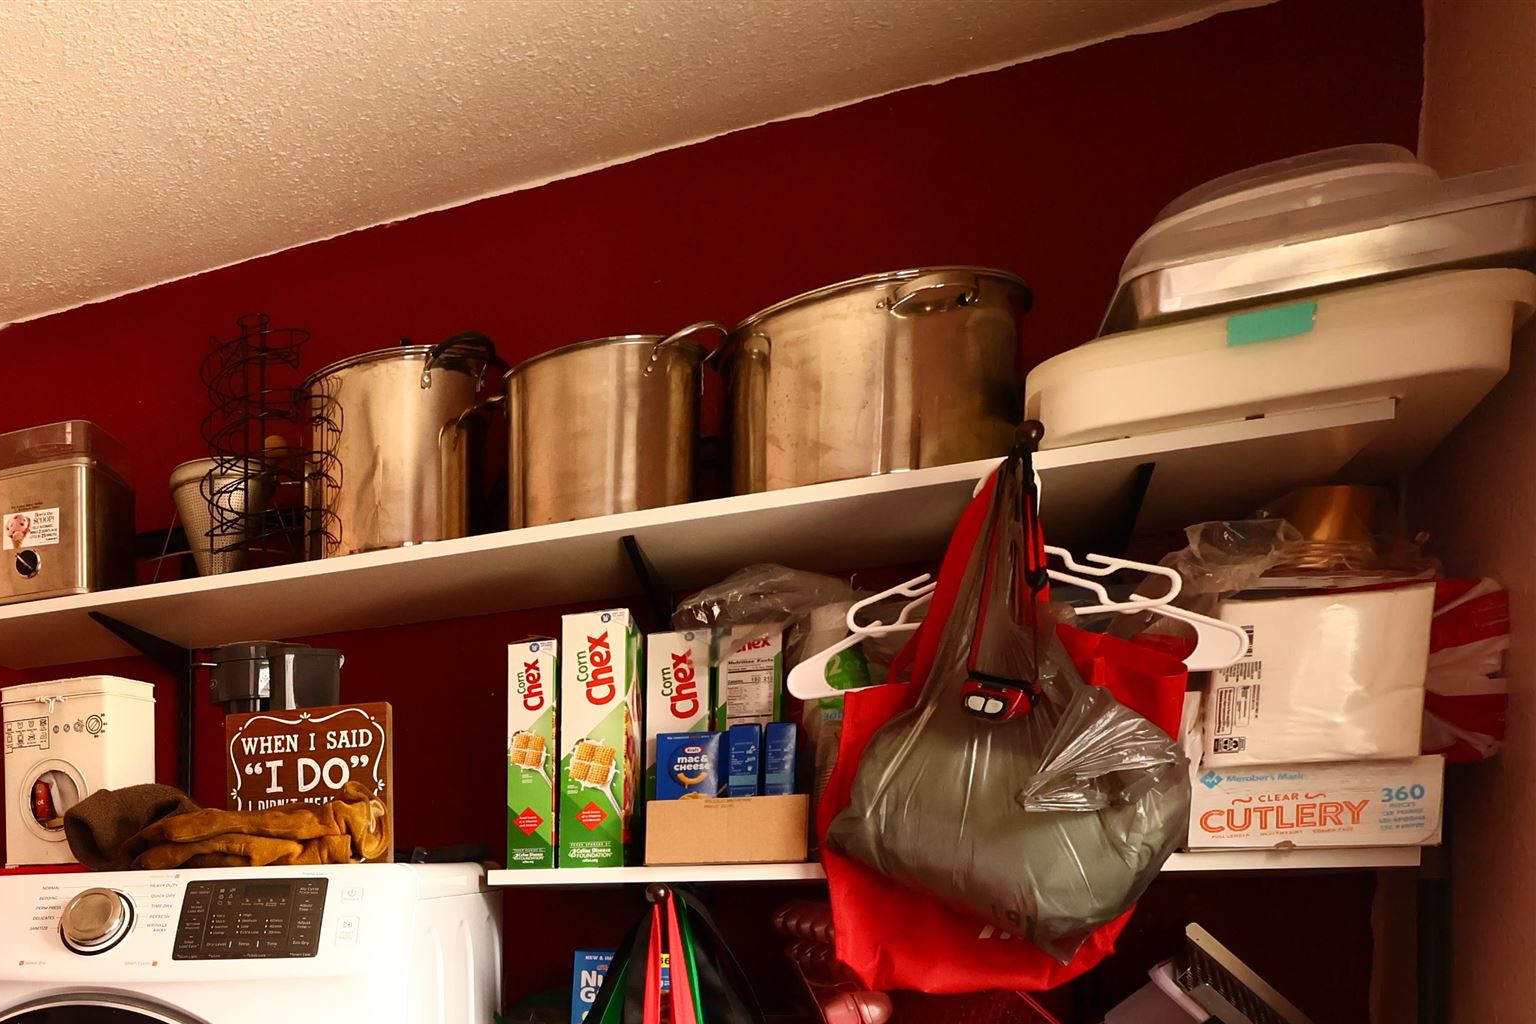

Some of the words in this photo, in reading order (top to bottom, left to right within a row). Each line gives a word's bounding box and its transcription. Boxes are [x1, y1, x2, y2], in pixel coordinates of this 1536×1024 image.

[577, 650, 589, 682] Corn
[586, 630, 616, 706] Chex
[517, 671, 526, 694] Corn
[523, 658, 545, 712] Chex
[661, 667, 673, 697] Corn
[670, 648, 699, 719] Chex
[241, 734, 299, 756] WHEN
[309, 733, 316, 751] I
[326, 728, 373, 750] SAID
[1226, 774, 1274, 783] Member's
[1381, 784, 1426, 803] 360
[1258, 792, 1300, 803] CLEAR
[1199, 799, 1371, 834] CUTLERY
